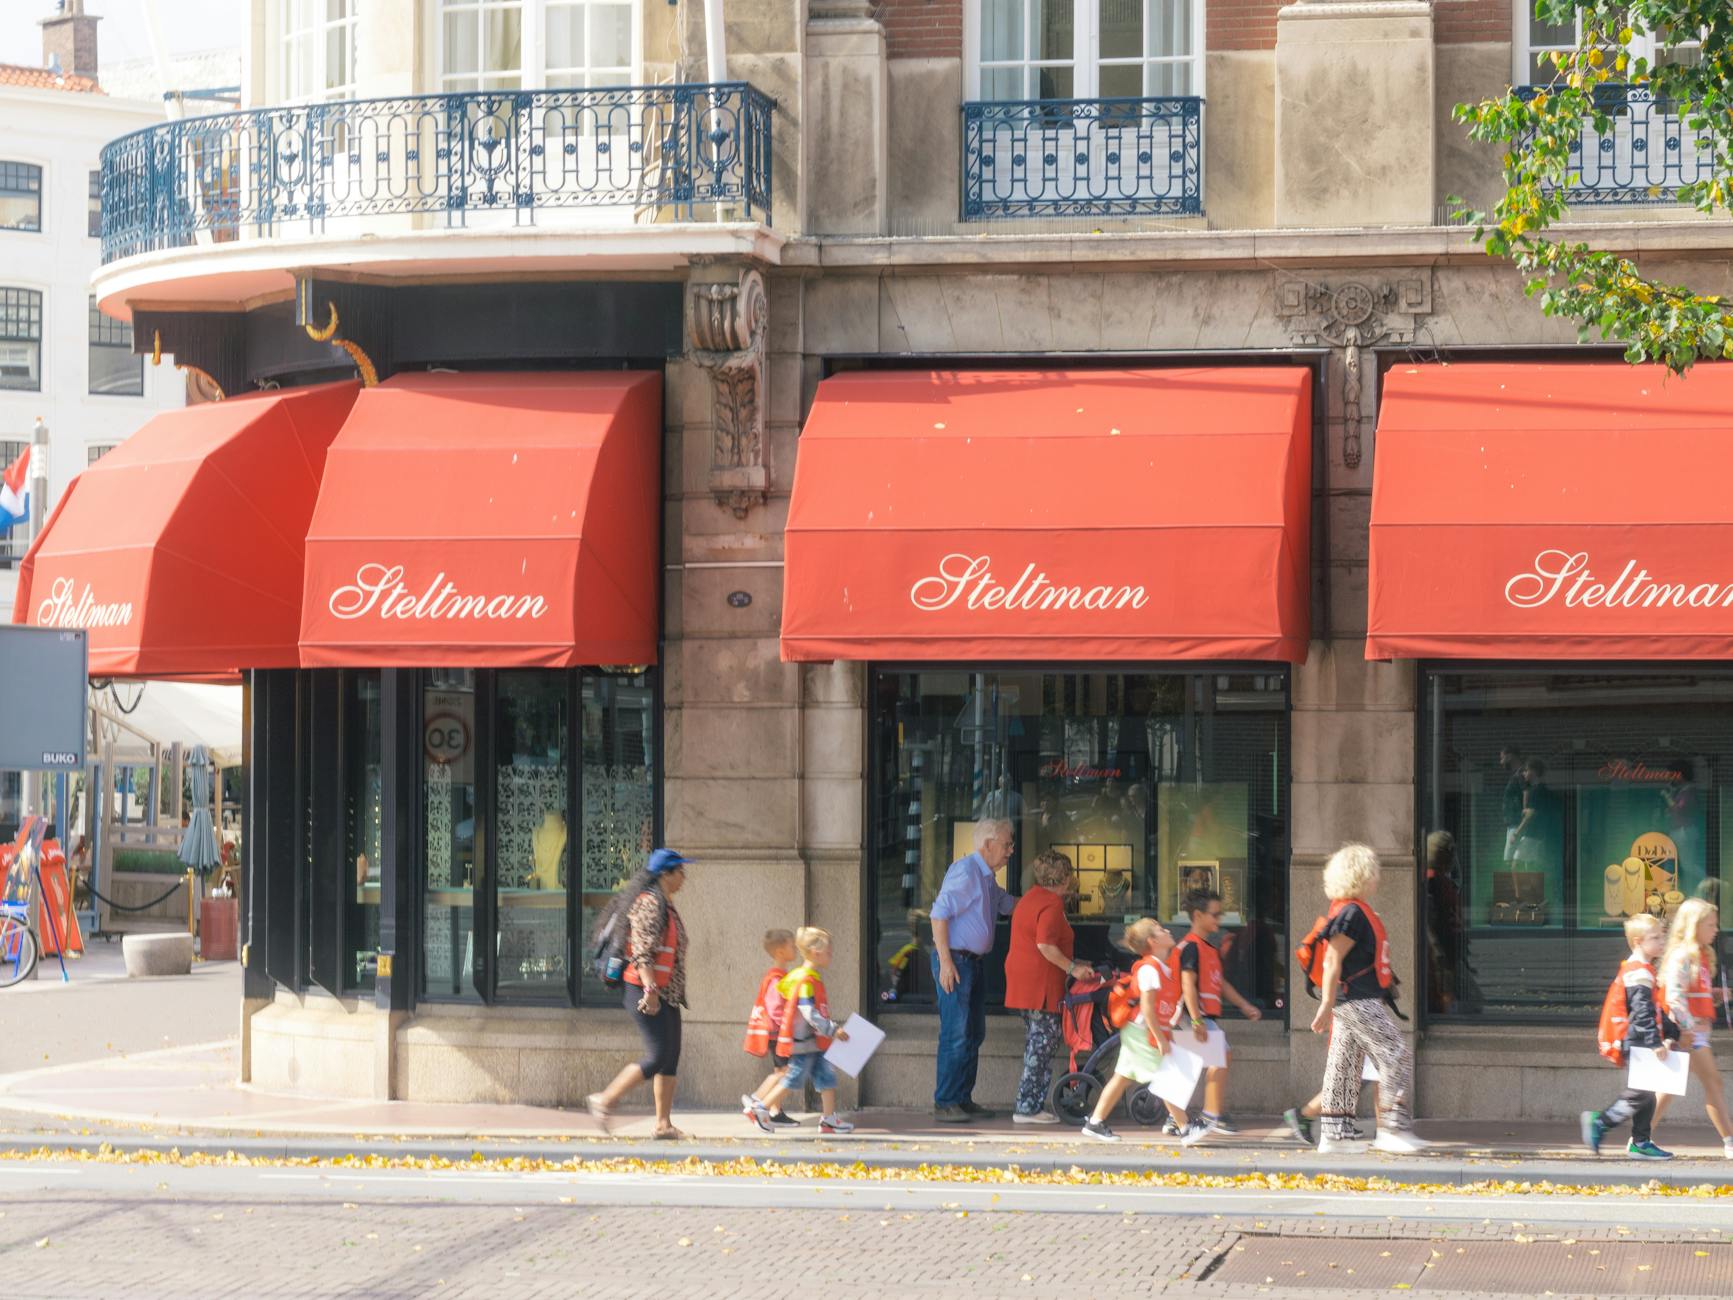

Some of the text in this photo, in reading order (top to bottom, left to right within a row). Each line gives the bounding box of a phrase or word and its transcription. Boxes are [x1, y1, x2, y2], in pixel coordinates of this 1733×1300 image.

[37, 576, 132, 628] Steltman
[329, 562, 548, 619] Steltman
[910, 553, 1150, 611] Steltman
[43, 752, 76, 764] BUKO
[1598, 759, 1683, 780] Steltman
